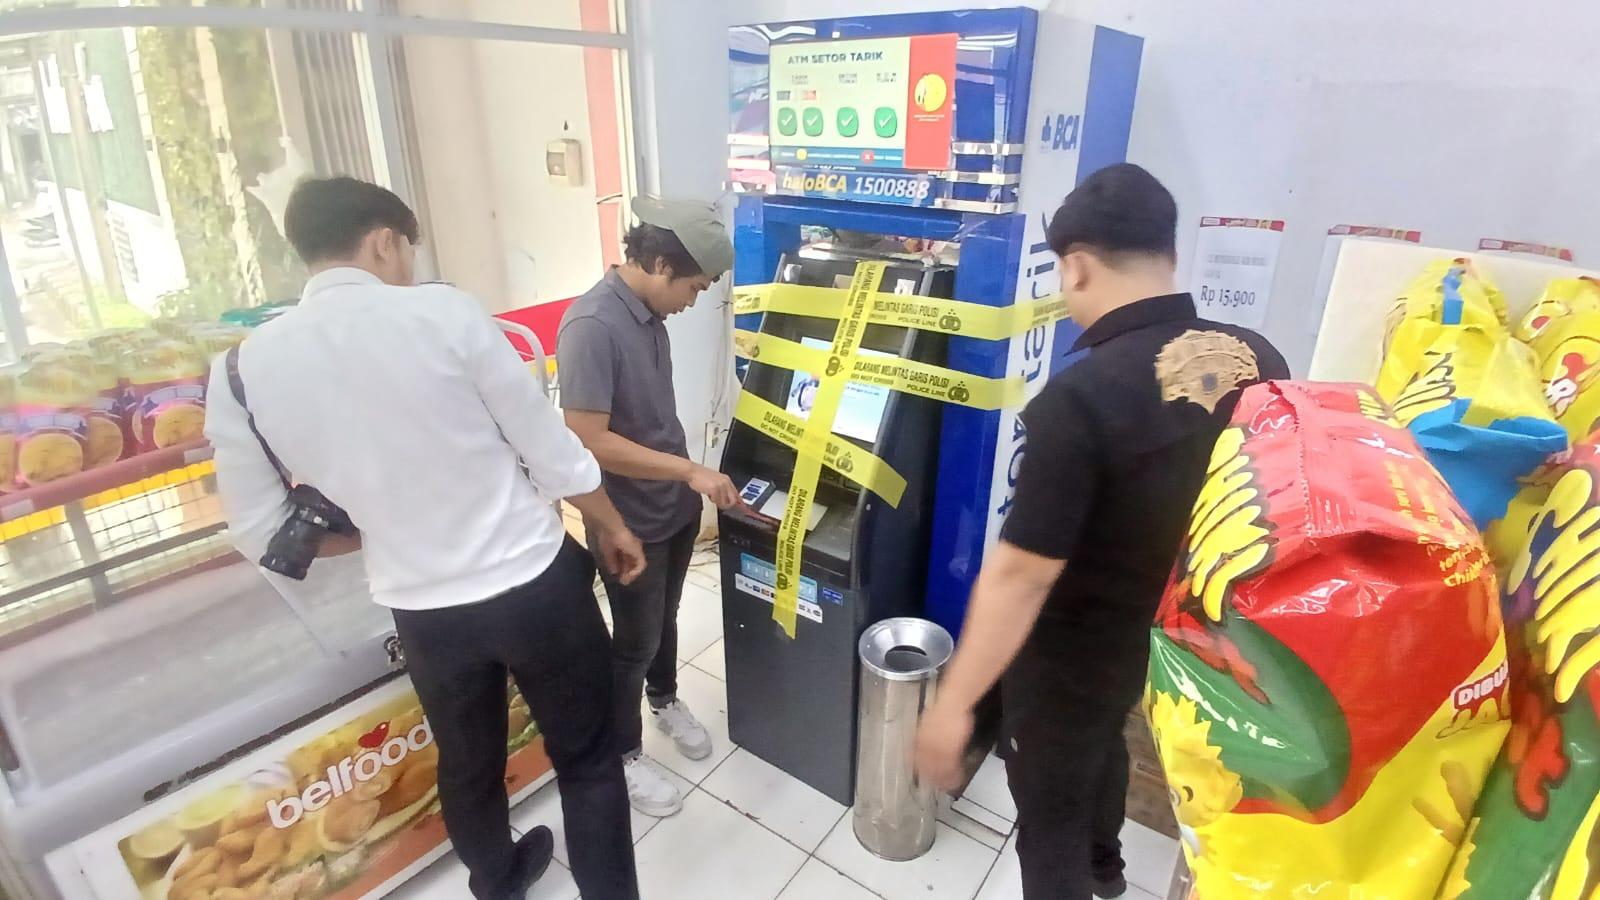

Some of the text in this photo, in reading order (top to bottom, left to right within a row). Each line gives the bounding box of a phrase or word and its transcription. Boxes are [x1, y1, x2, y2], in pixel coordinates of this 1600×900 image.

[788, 51, 883, 64] ATM SETOR TARIK
[1052, 114, 1080, 150] BCA
[782, 171, 931, 199] haloBCA 1500888
[1200, 285, 1256, 307] Rp 15.900
[853, 361, 950, 388] DILARANG MELINTAS GARIS POLISI
[906, 383, 929, 394] POLICE
[930, 388, 946, 397] LINE
[764, 411, 787, 430] DILARANG
[265, 715, 435, 829] belfood
